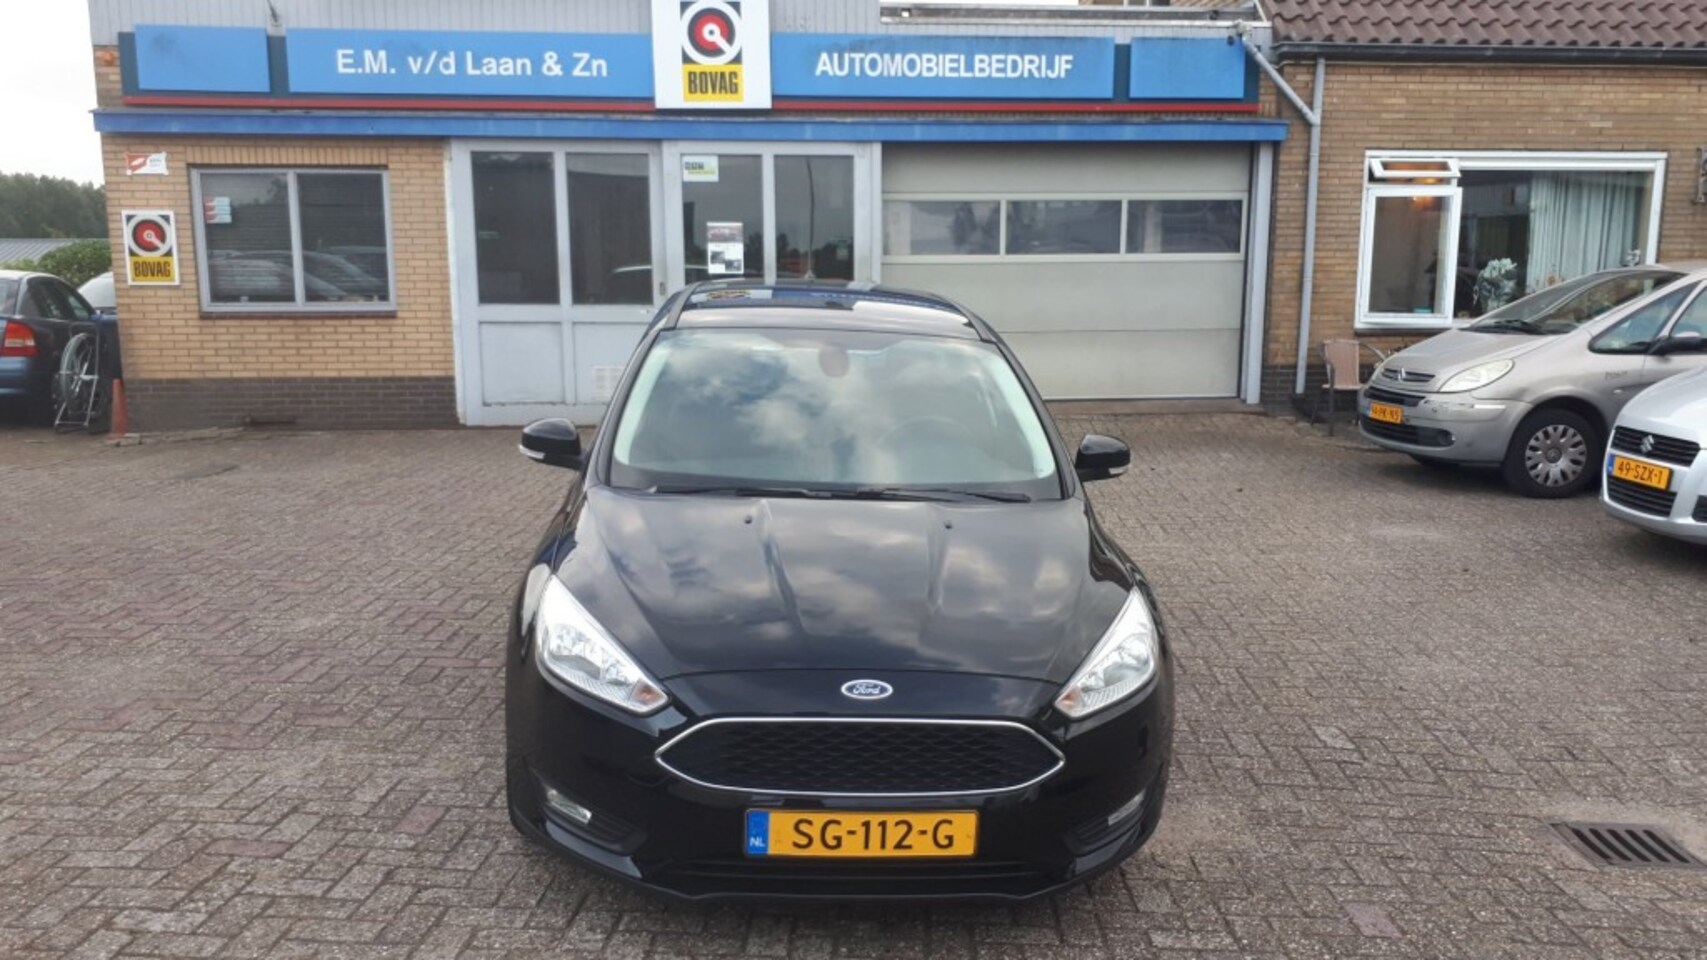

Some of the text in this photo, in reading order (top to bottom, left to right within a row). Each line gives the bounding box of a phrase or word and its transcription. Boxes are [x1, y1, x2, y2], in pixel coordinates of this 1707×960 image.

[336, 49, 608, 77] E.M. v/d Laan & Zn
[815, 52, 1074, 79] AUTOMOBIELBEDRIJF
[688, 71, 738, 94] BOVAG
[133, 260, 171, 276] BOVAG
[1618, 461, 1663, 484] 49-SZX-1
[853, 684, 881, 694] Ford
[750, 818, 954, 850] NL SG-112-G
